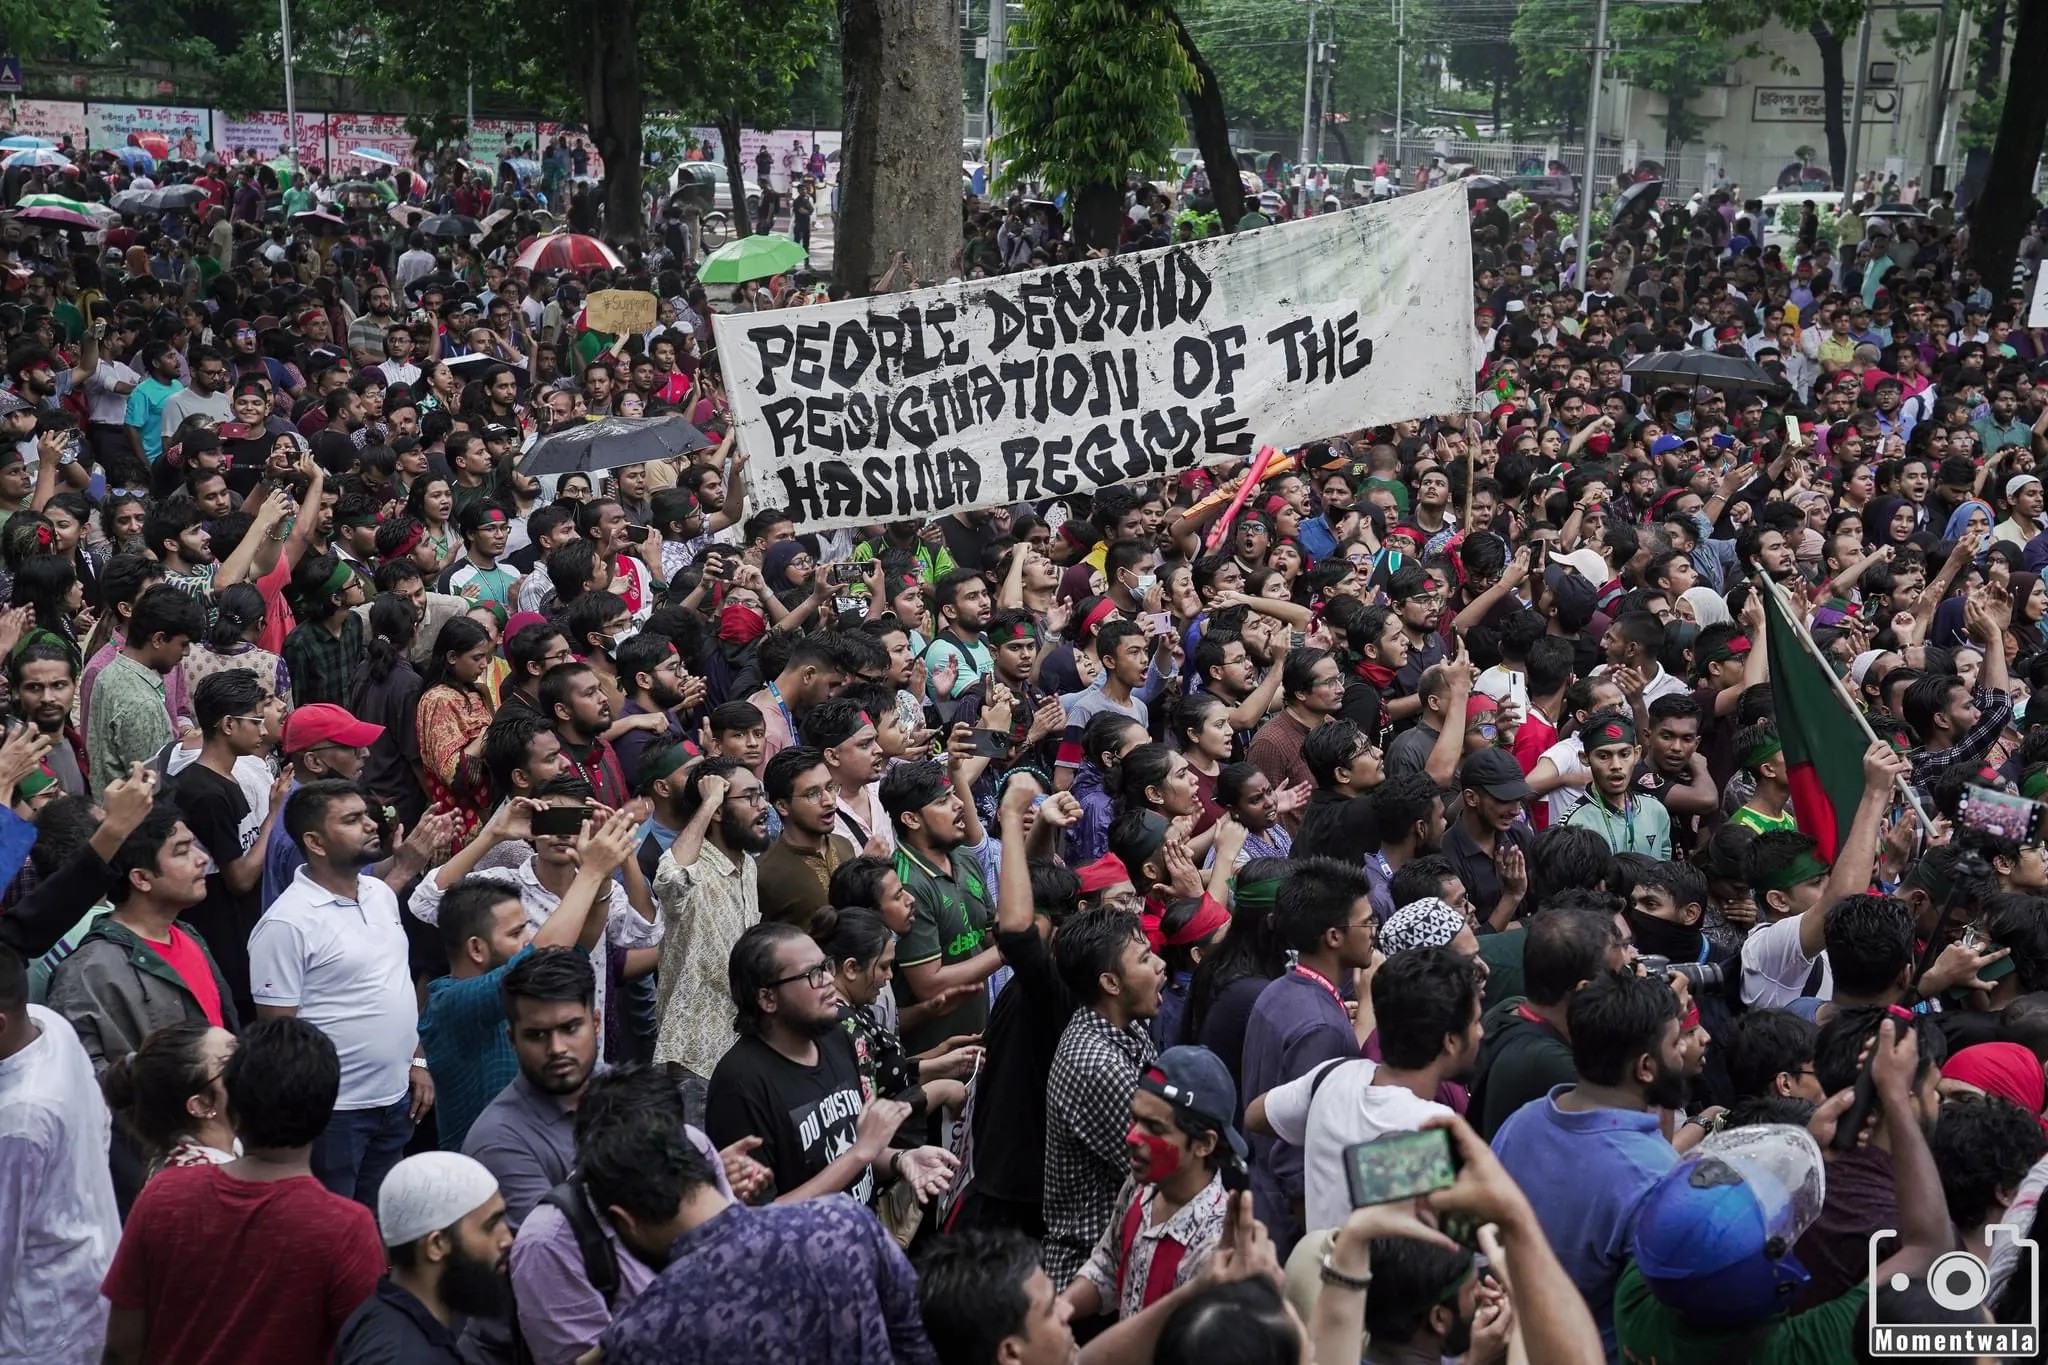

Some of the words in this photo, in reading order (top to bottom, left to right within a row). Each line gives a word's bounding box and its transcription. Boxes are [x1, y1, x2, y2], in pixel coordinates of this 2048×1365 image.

[749, 302, 969, 395] PEOPLE
[987, 248, 1211, 352] DEMAND
[761, 347, 1138, 457] RESIGNATION
[1172, 324, 1246, 398] OF
[1267, 310, 1373, 384] THE
[776, 447, 980, 523] HASINA
[1002, 396, 1255, 500] REGIME
[799, 1110, 820, 1152] DU
